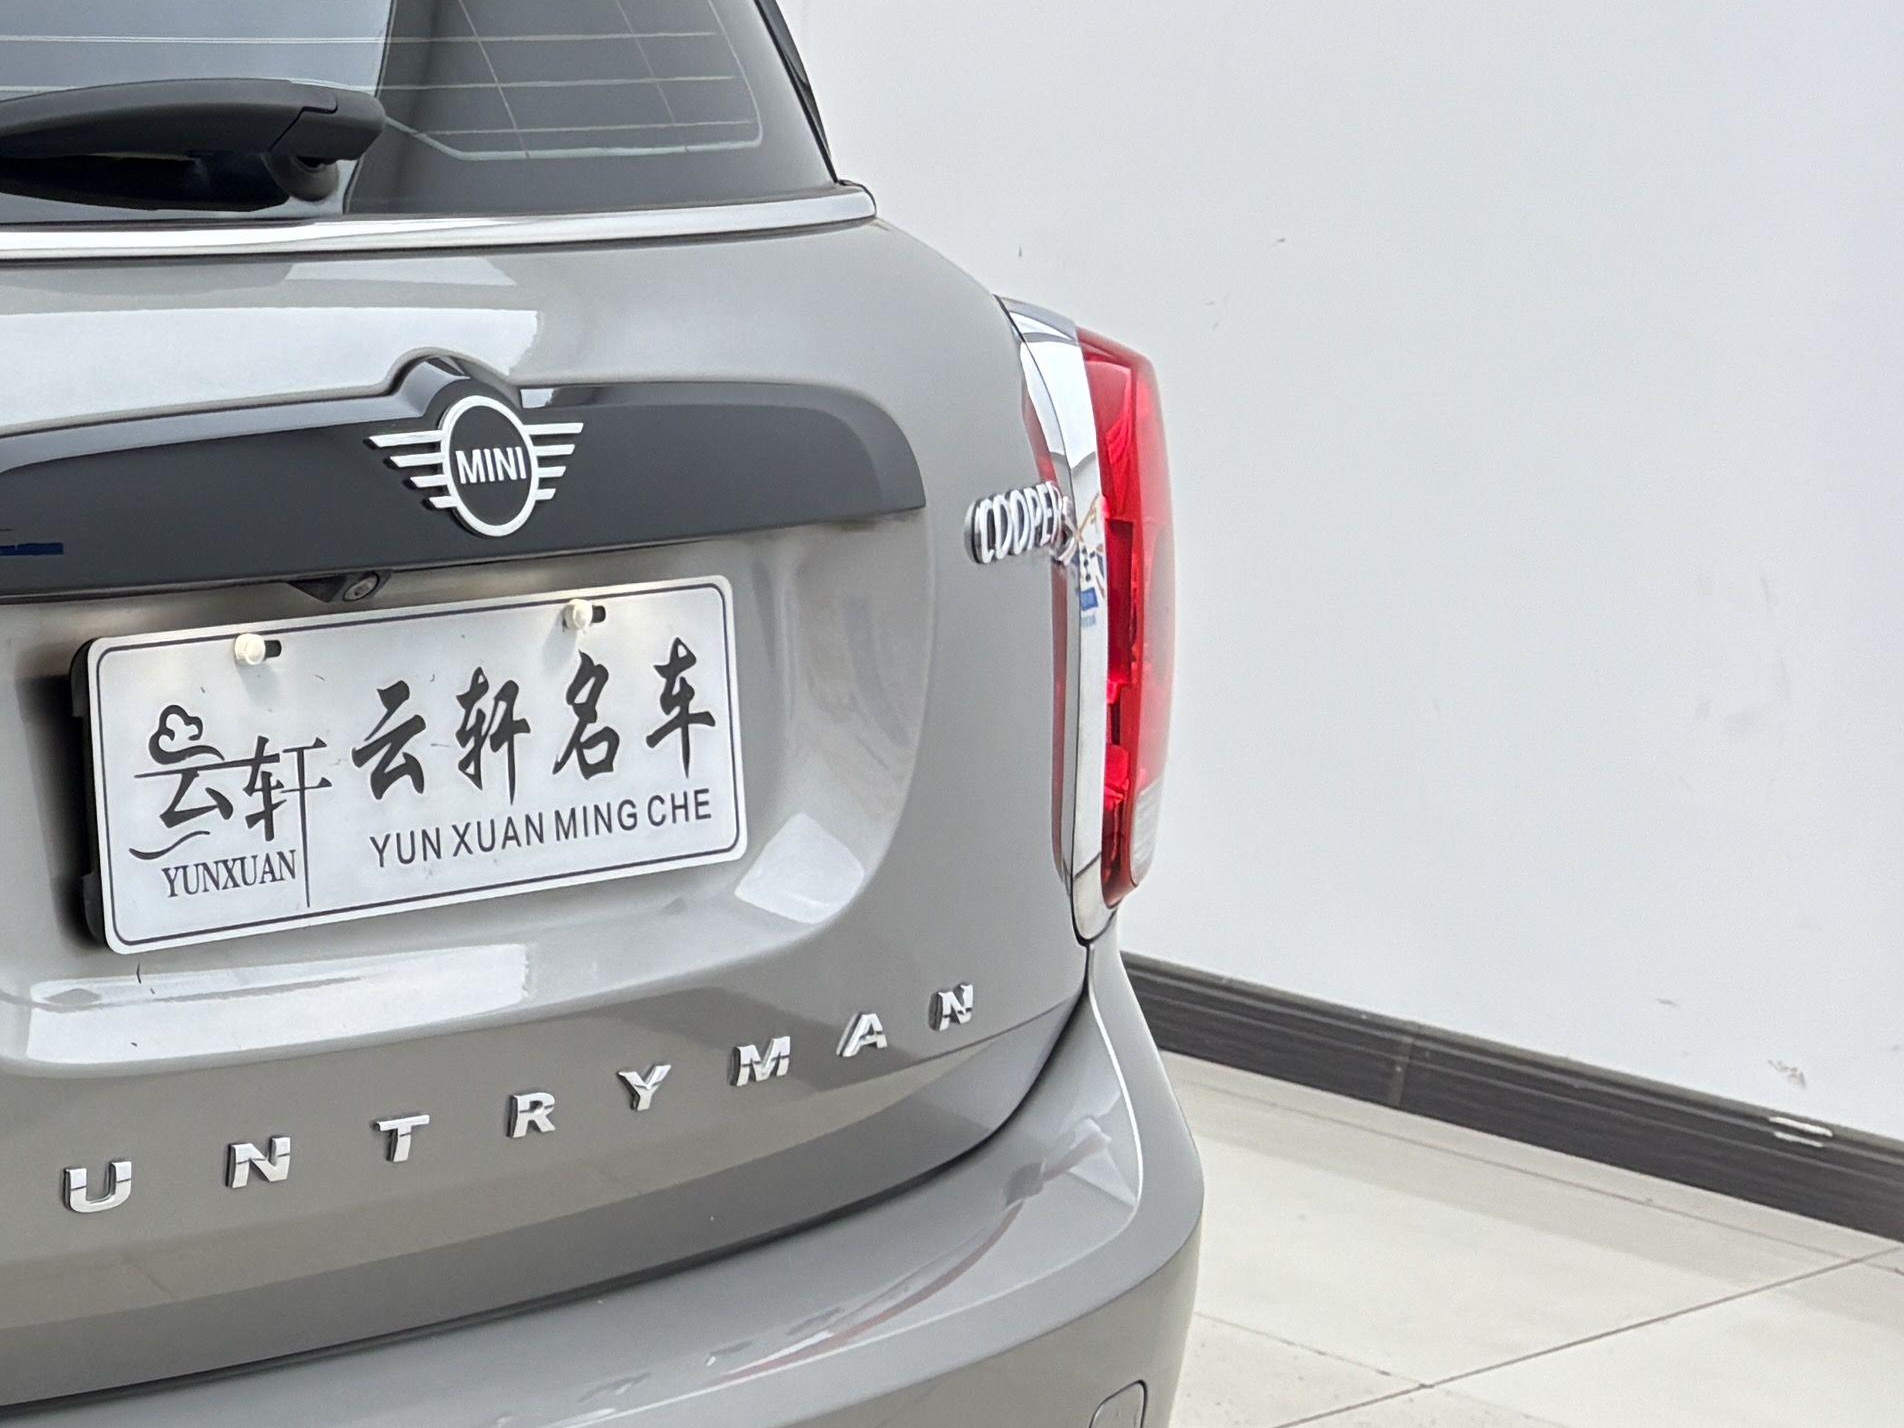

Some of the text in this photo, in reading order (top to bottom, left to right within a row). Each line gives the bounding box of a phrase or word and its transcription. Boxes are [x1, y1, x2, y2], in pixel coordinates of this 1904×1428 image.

[455, 446, 527, 485] MINI
[351, 636, 717, 805] 云轩名车
[370, 787, 713, 869] YUN XUAN MING CHE
[161, 849, 297, 899] YUNXUAN
